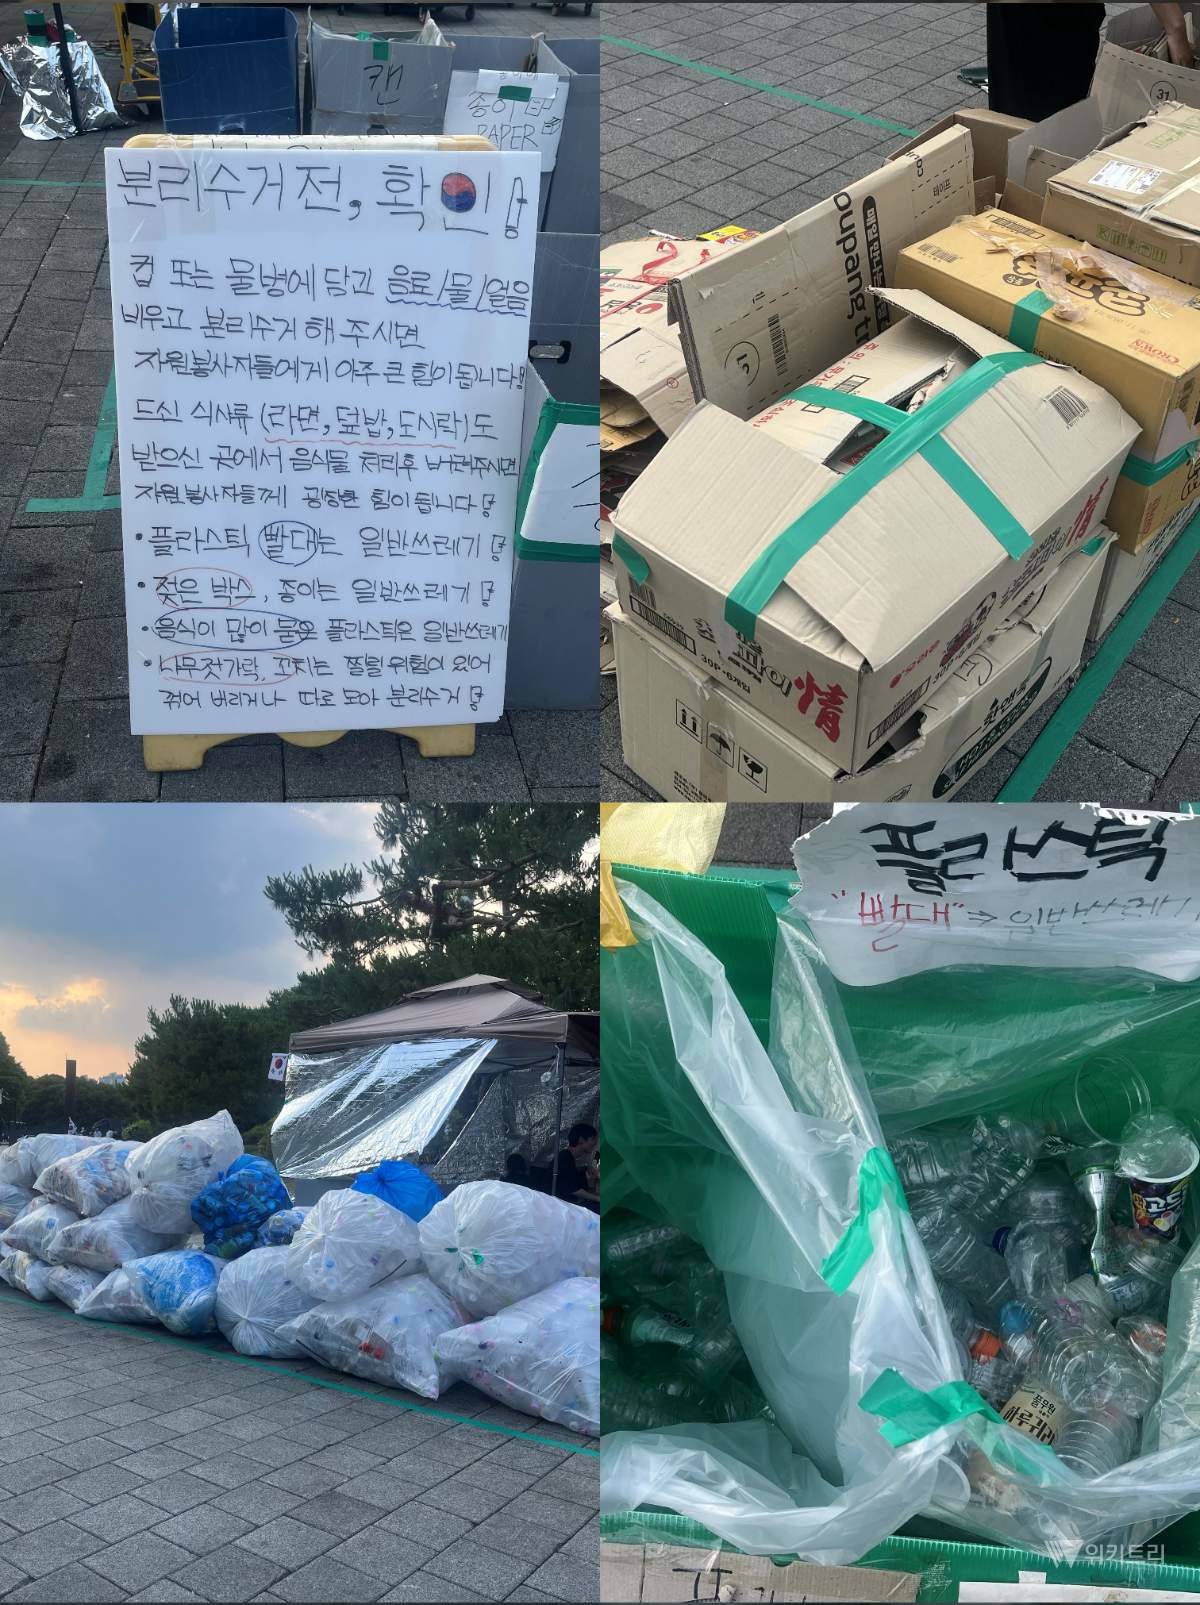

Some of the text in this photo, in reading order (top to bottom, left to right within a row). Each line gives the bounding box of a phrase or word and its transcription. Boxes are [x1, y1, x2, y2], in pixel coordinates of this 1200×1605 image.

[364, 64, 404, 106] 캔
[1156, 88, 1170, 101] 31
[477, 124, 539, 150] PAPER
[116, 158, 284, 212] 분리수거
[376, 163, 491, 237] 확인
[130, 255, 154, 288] 컵
[169, 258, 215, 290] 또는
[225, 257, 316, 302] 물병에
[324, 263, 375, 297] 담긴
[121, 303, 192, 332] 비우고
[200, 305, 297, 342] 분리수거
[134, 346, 330, 384] 자원봉사자들에게
[334, 357, 381, 387] 아주
[383, 361, 406, 384] 큰
[411, 359, 452, 388] 힘이
[133, 399, 184, 423] 드신
[132, 440, 204, 472] 받으신
[209, 445, 283, 474] 곳에서
[289, 447, 351, 474] 음식물
[134, 483, 287, 509] 자원봉사자들께
[147, 523, 251, 558] 플라스틱
[358, 526, 481, 558] 일반쓰레기
[153, 575, 203, 607] 젖은
[277, 576, 342, 604] 종이는
[351, 578, 470, 604] 일반쓰레기
[154, 617, 216, 640] 음식이
[226, 616, 267, 644] 많이
[325, 618, 417, 642] 플라스틱은
[423, 620, 508, 643] 일반쓰레기
[452, 653, 491, 675] 있어
[210, 689, 288, 709] 버리거나
[297, 687, 337, 708] 따로
[342, 687, 381, 708] 모아
[386, 684, 461, 708] 분리수거
[793, 669, 849, 744] 情
[1031, 1393, 1057, 1416] 풀무원
